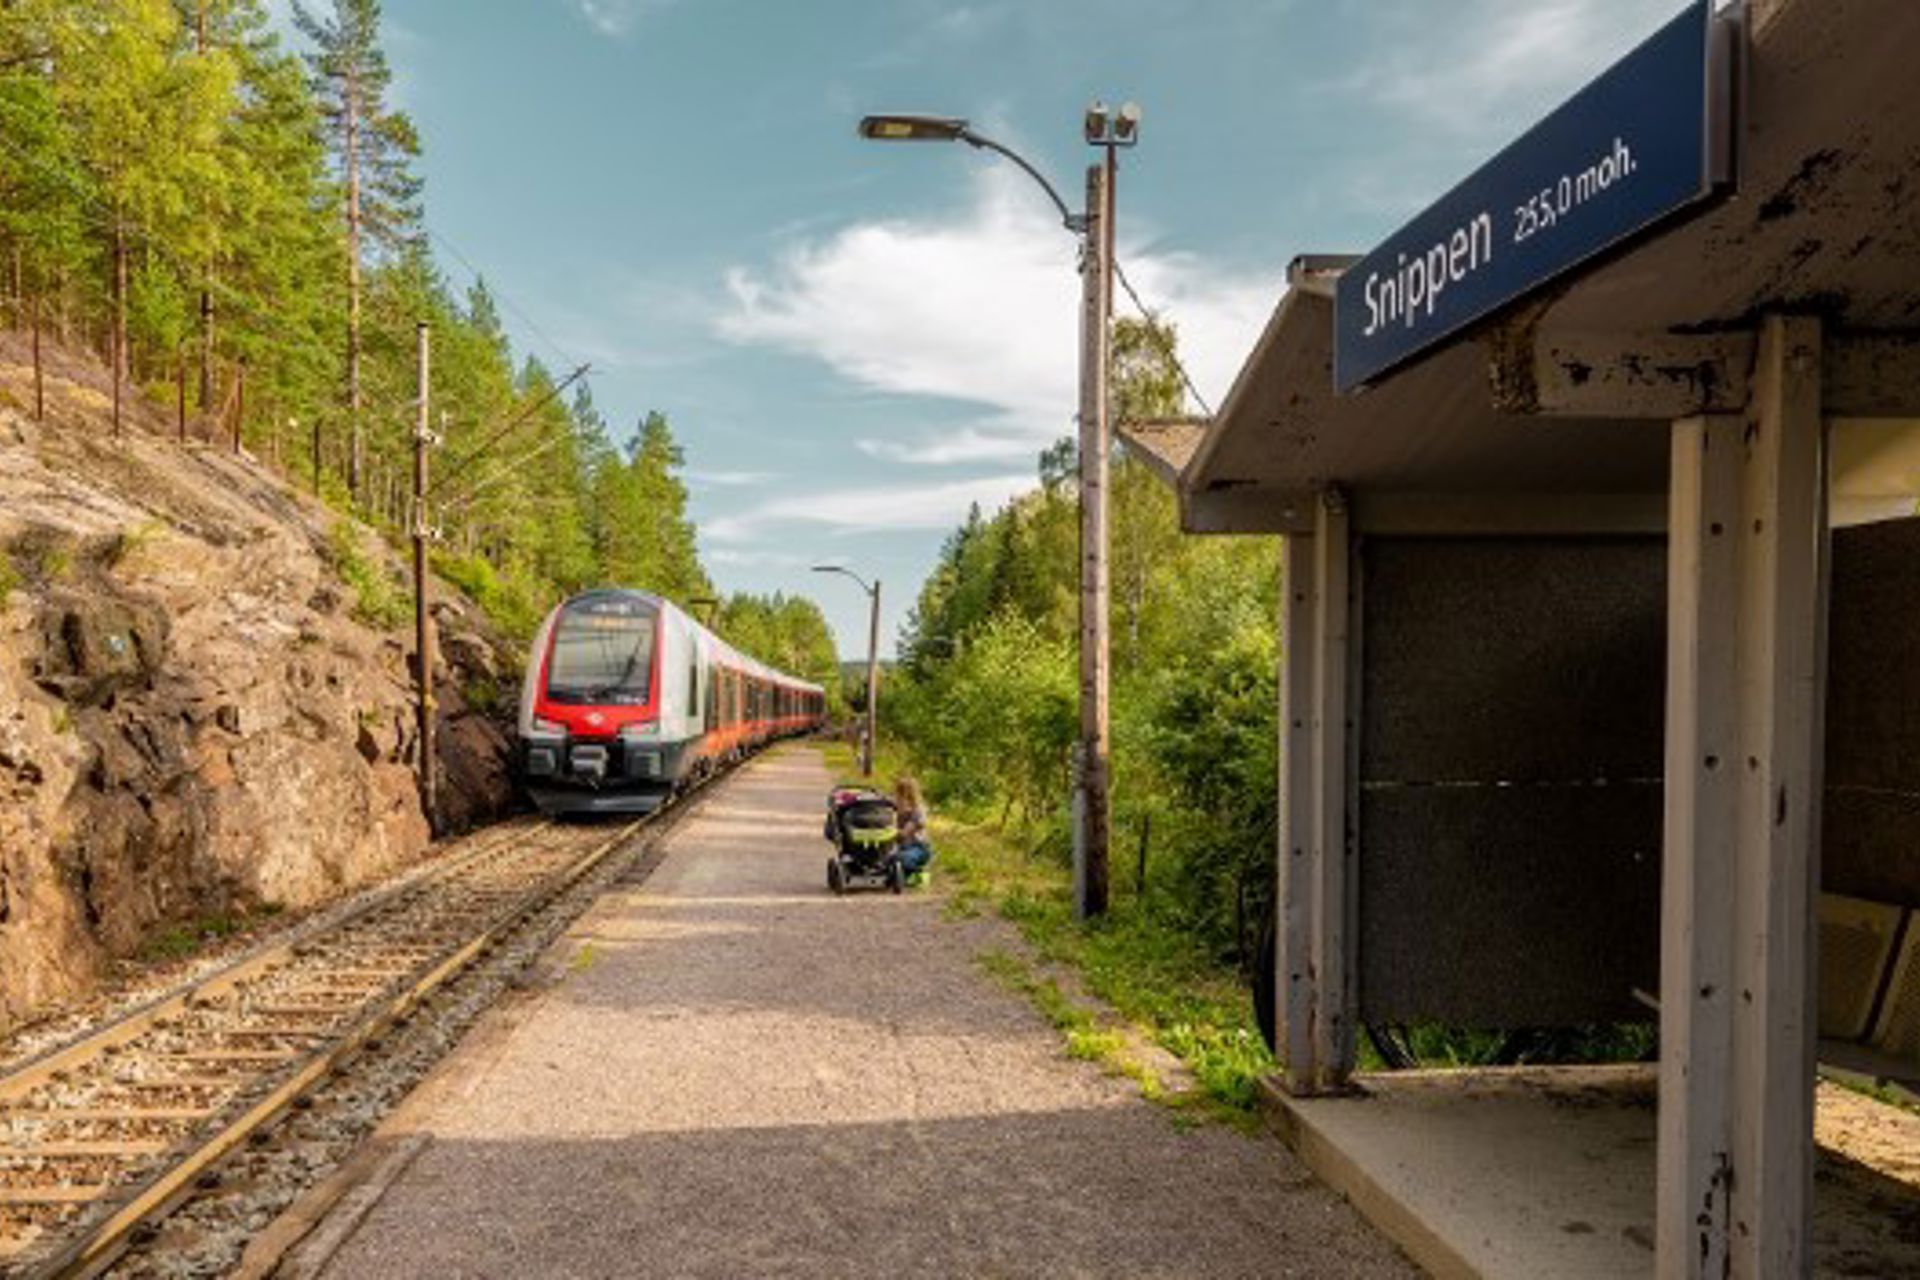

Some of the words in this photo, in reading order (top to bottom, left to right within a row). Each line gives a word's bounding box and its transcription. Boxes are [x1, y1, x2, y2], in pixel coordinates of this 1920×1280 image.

[1363, 211, 1491, 336] Snippen
[1514, 175, 1571, 242] 255,0
[1575, 137, 1637, 203] moh.
